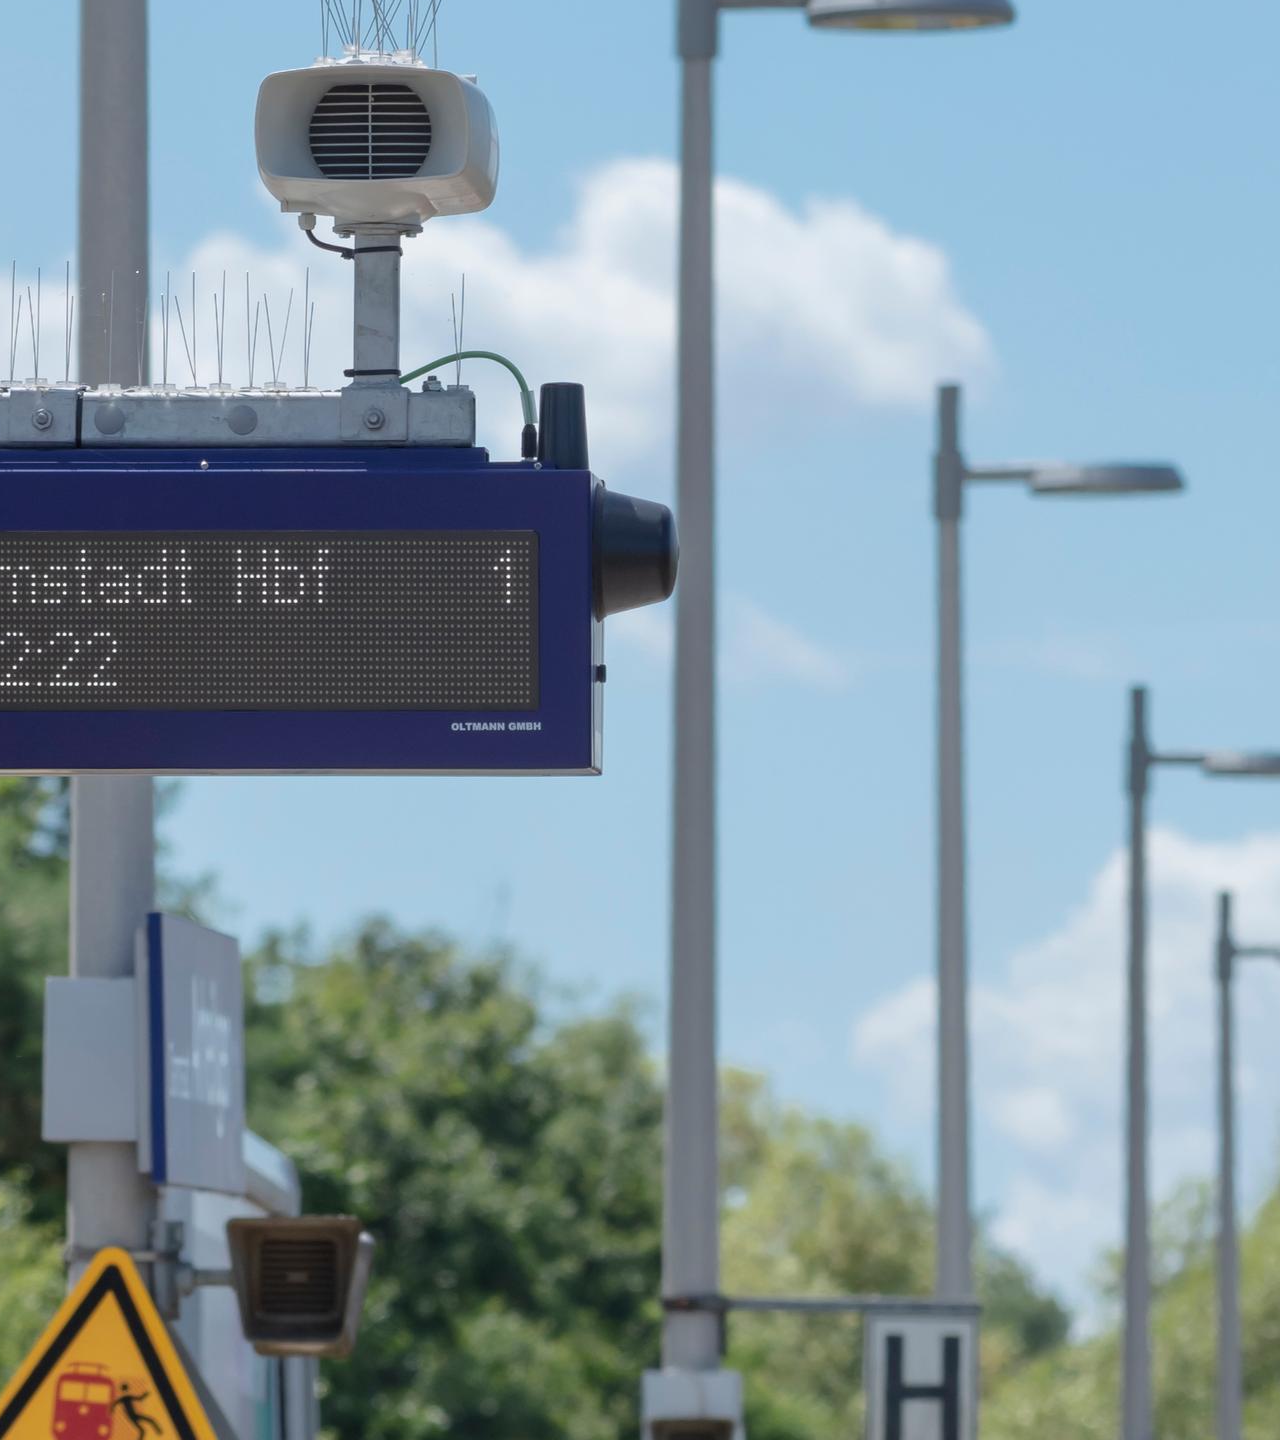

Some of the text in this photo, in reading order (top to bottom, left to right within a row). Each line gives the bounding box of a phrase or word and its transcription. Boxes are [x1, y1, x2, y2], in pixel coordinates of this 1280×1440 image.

[236, 548, 330, 604] Hbf
[493, 548, 511, 604] 1
[451, 722, 541, 731] OLTMANN GMBH
